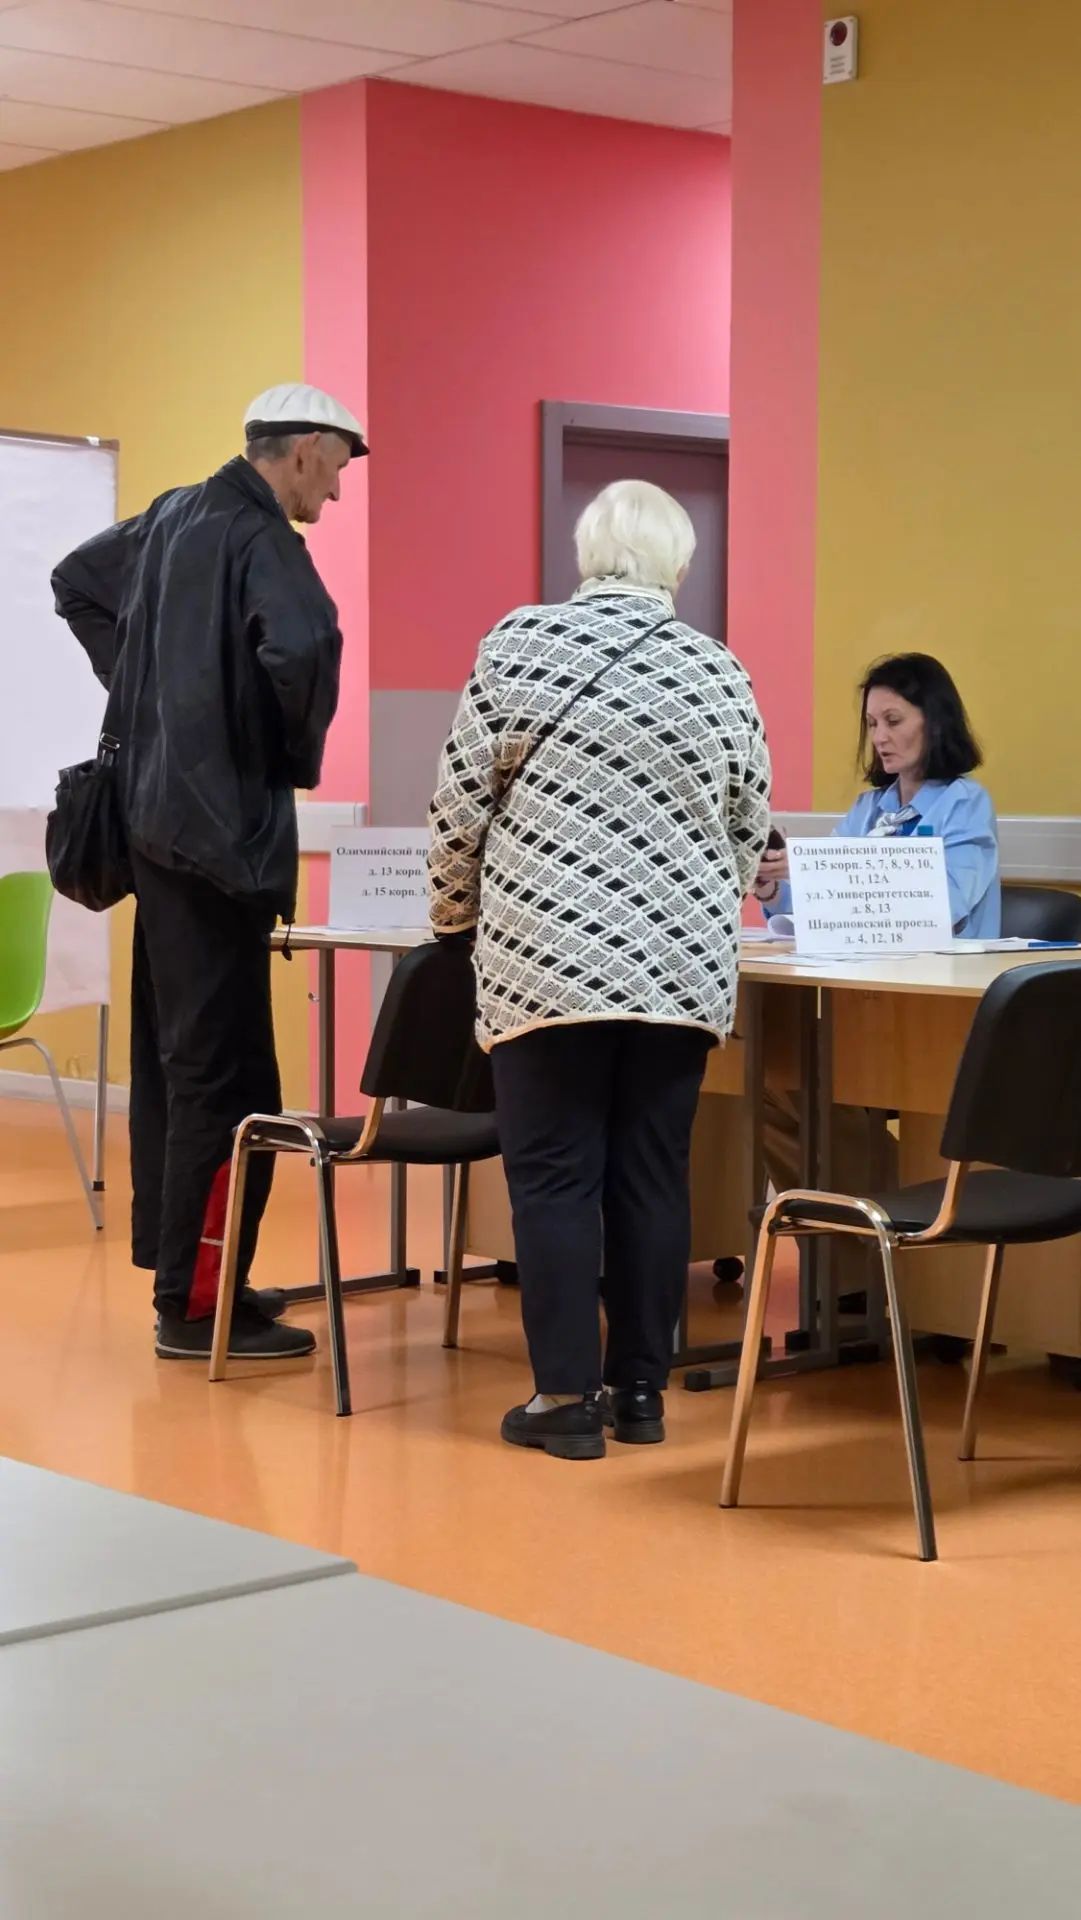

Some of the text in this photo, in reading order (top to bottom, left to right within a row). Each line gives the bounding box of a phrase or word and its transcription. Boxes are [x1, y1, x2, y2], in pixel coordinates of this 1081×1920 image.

[336, 846, 412, 856] Олимпийский
[793, 845, 877, 857] Олимпийский
[381, 866, 393, 876] 13
[395, 869, 424, 878] корп.
[814, 860, 828, 870] 15
[830, 862, 863, 872] корп.
[848, 874, 865, 886] 11,
[374, 887, 387, 897] 15
[388, 889, 418, 898] корп.
[878, 903, 891, 913] 13
[808, 918, 892, 931] Шараповский
[890, 932, 904, 943] 18
